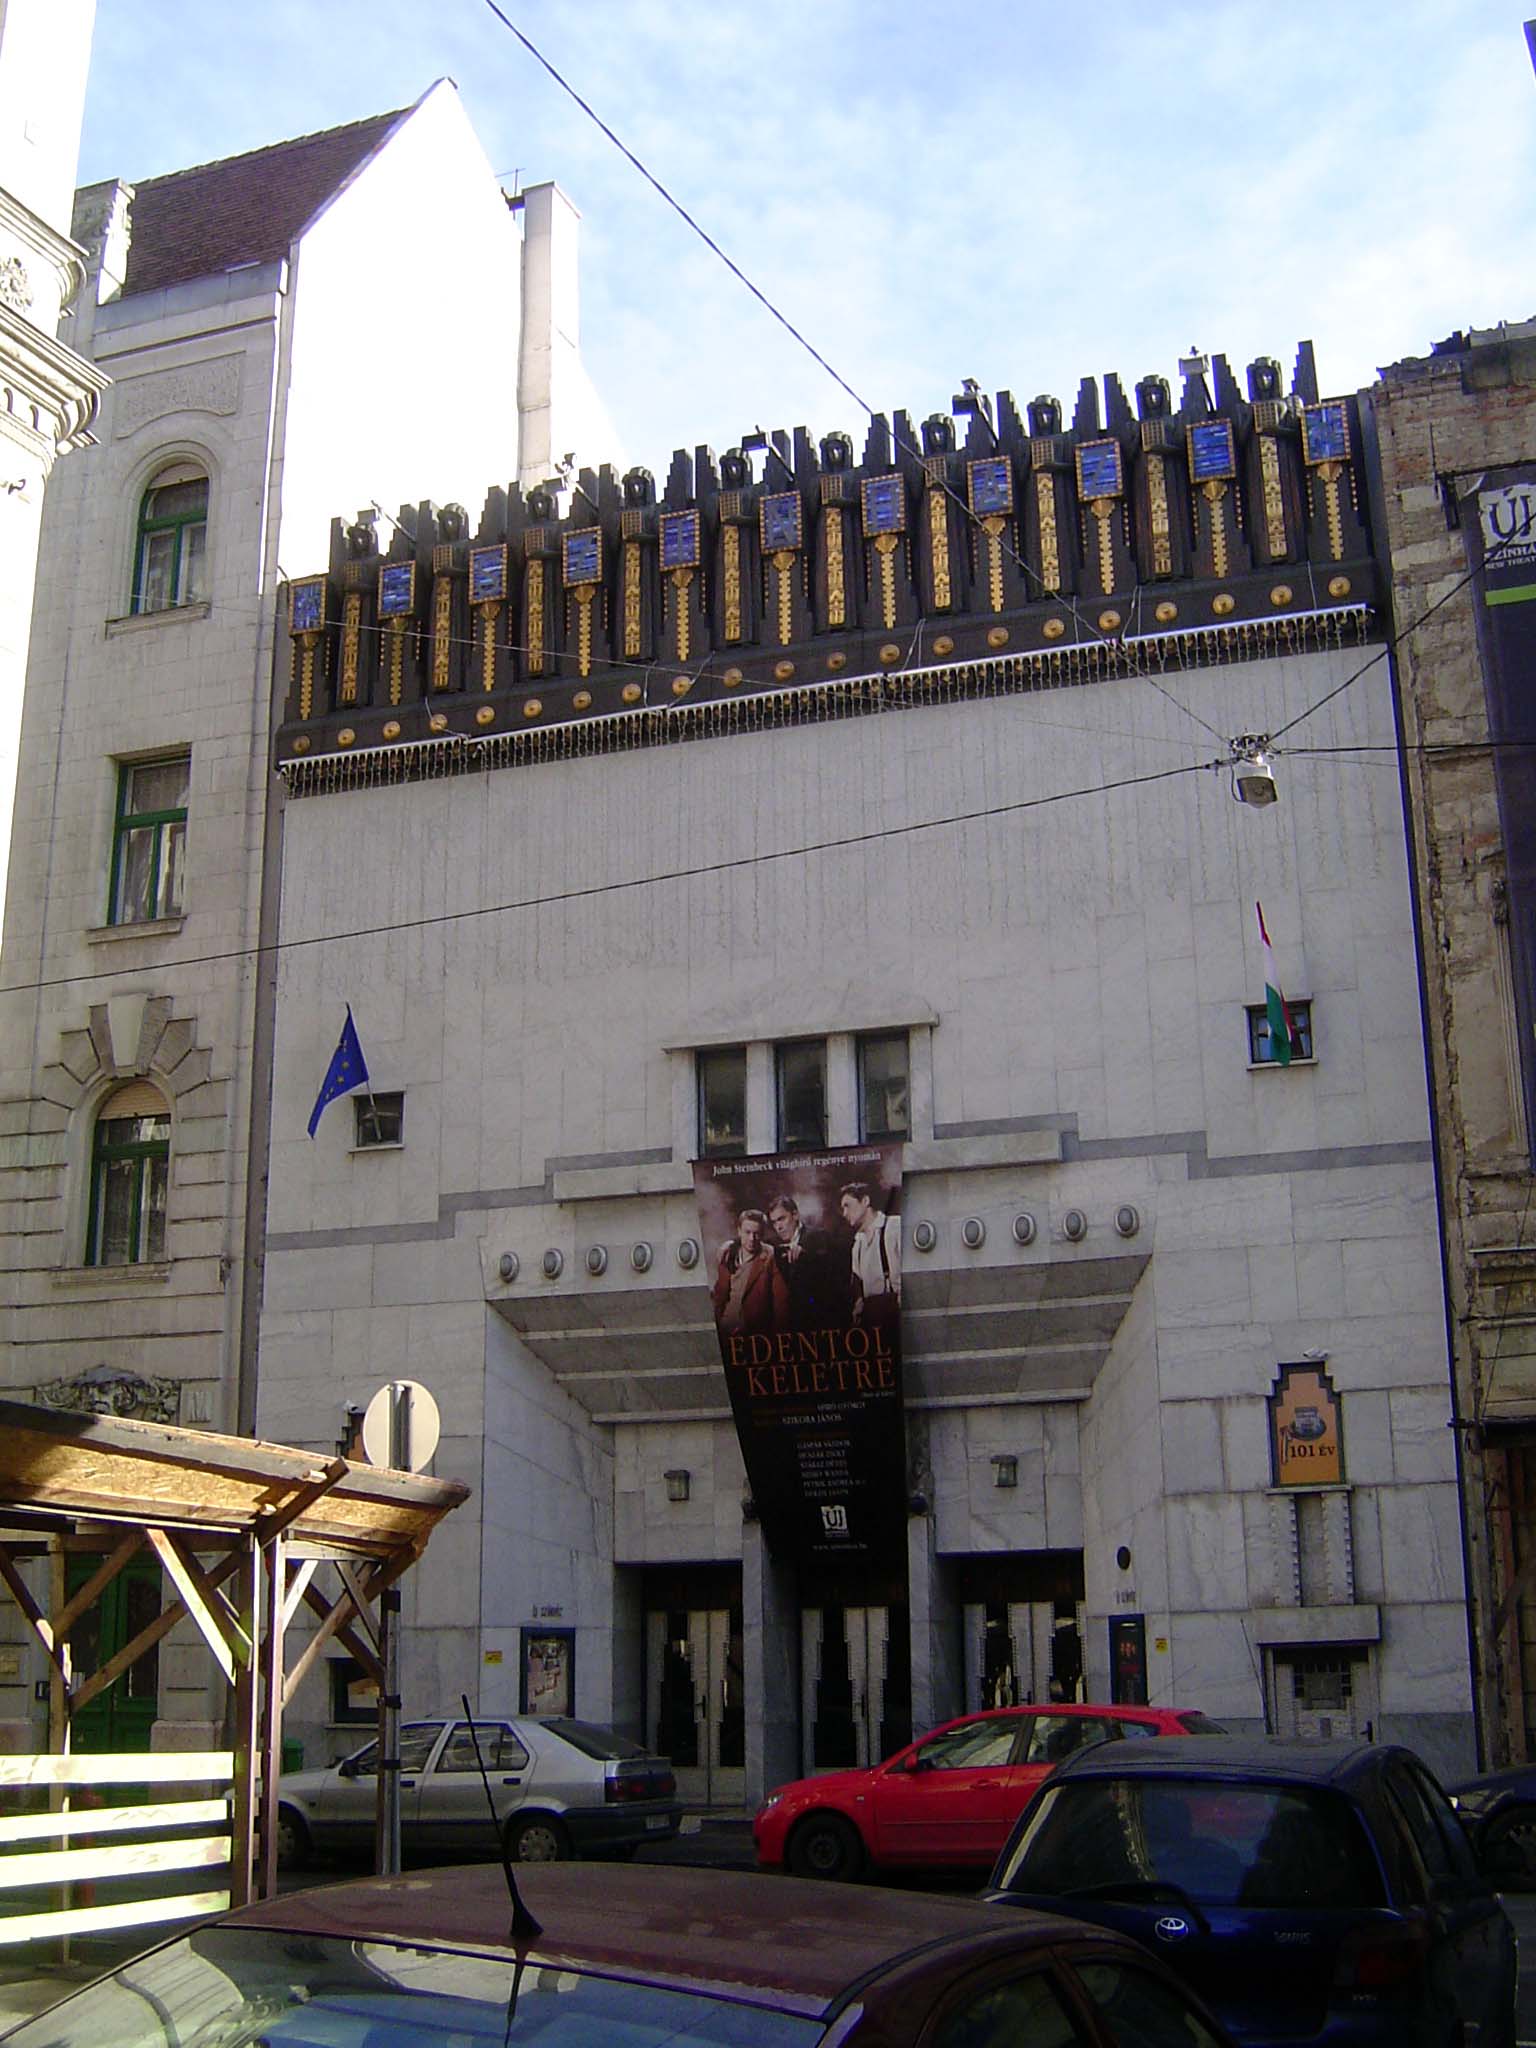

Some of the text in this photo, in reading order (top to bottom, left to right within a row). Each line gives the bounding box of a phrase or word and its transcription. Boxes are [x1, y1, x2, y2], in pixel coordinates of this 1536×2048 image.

[713, 1165, 733, 1177] John
[734, 1160, 774, 1174] Steinbeck
[746, 1359, 896, 1397] KELETRE
[1290, 1444, 1316, 1458] 101
